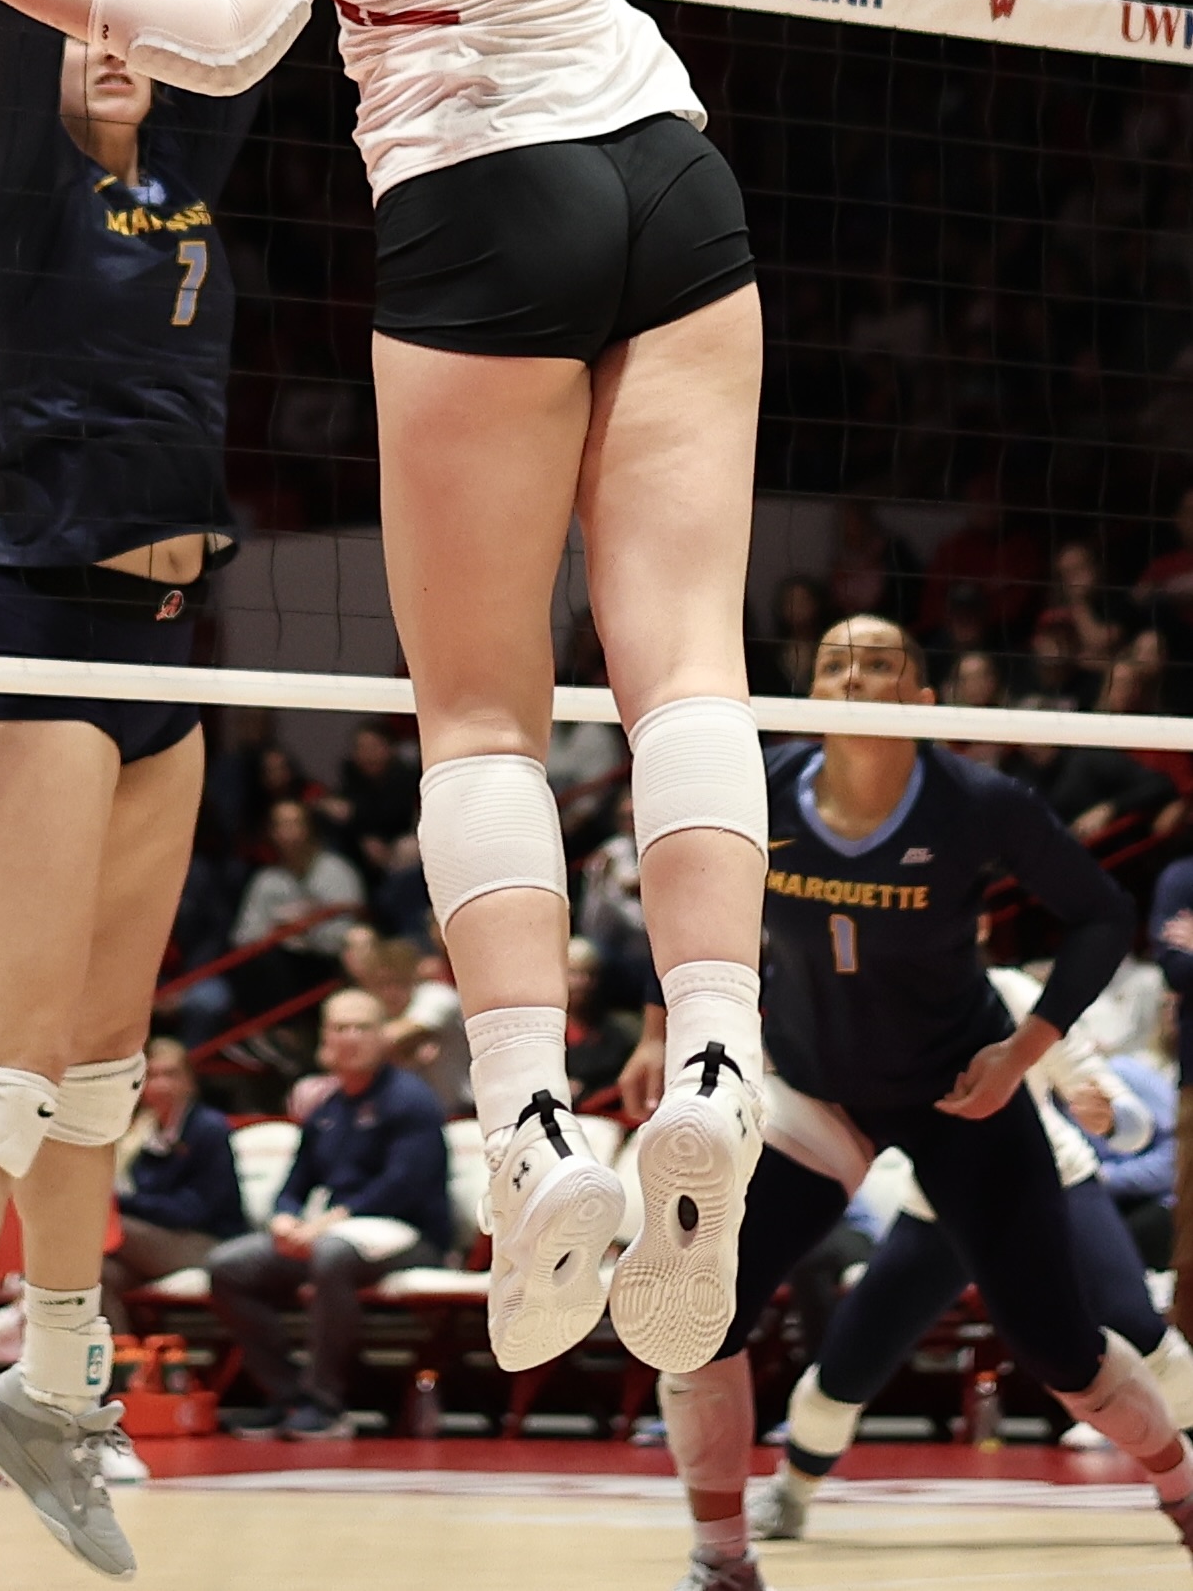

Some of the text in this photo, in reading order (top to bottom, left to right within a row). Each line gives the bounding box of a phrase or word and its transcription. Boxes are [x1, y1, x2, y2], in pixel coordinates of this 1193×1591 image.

[170, 239, 208, 326] 7
[766, 868, 930, 910] MARQUETTE
[828, 912, 859, 975] 1
